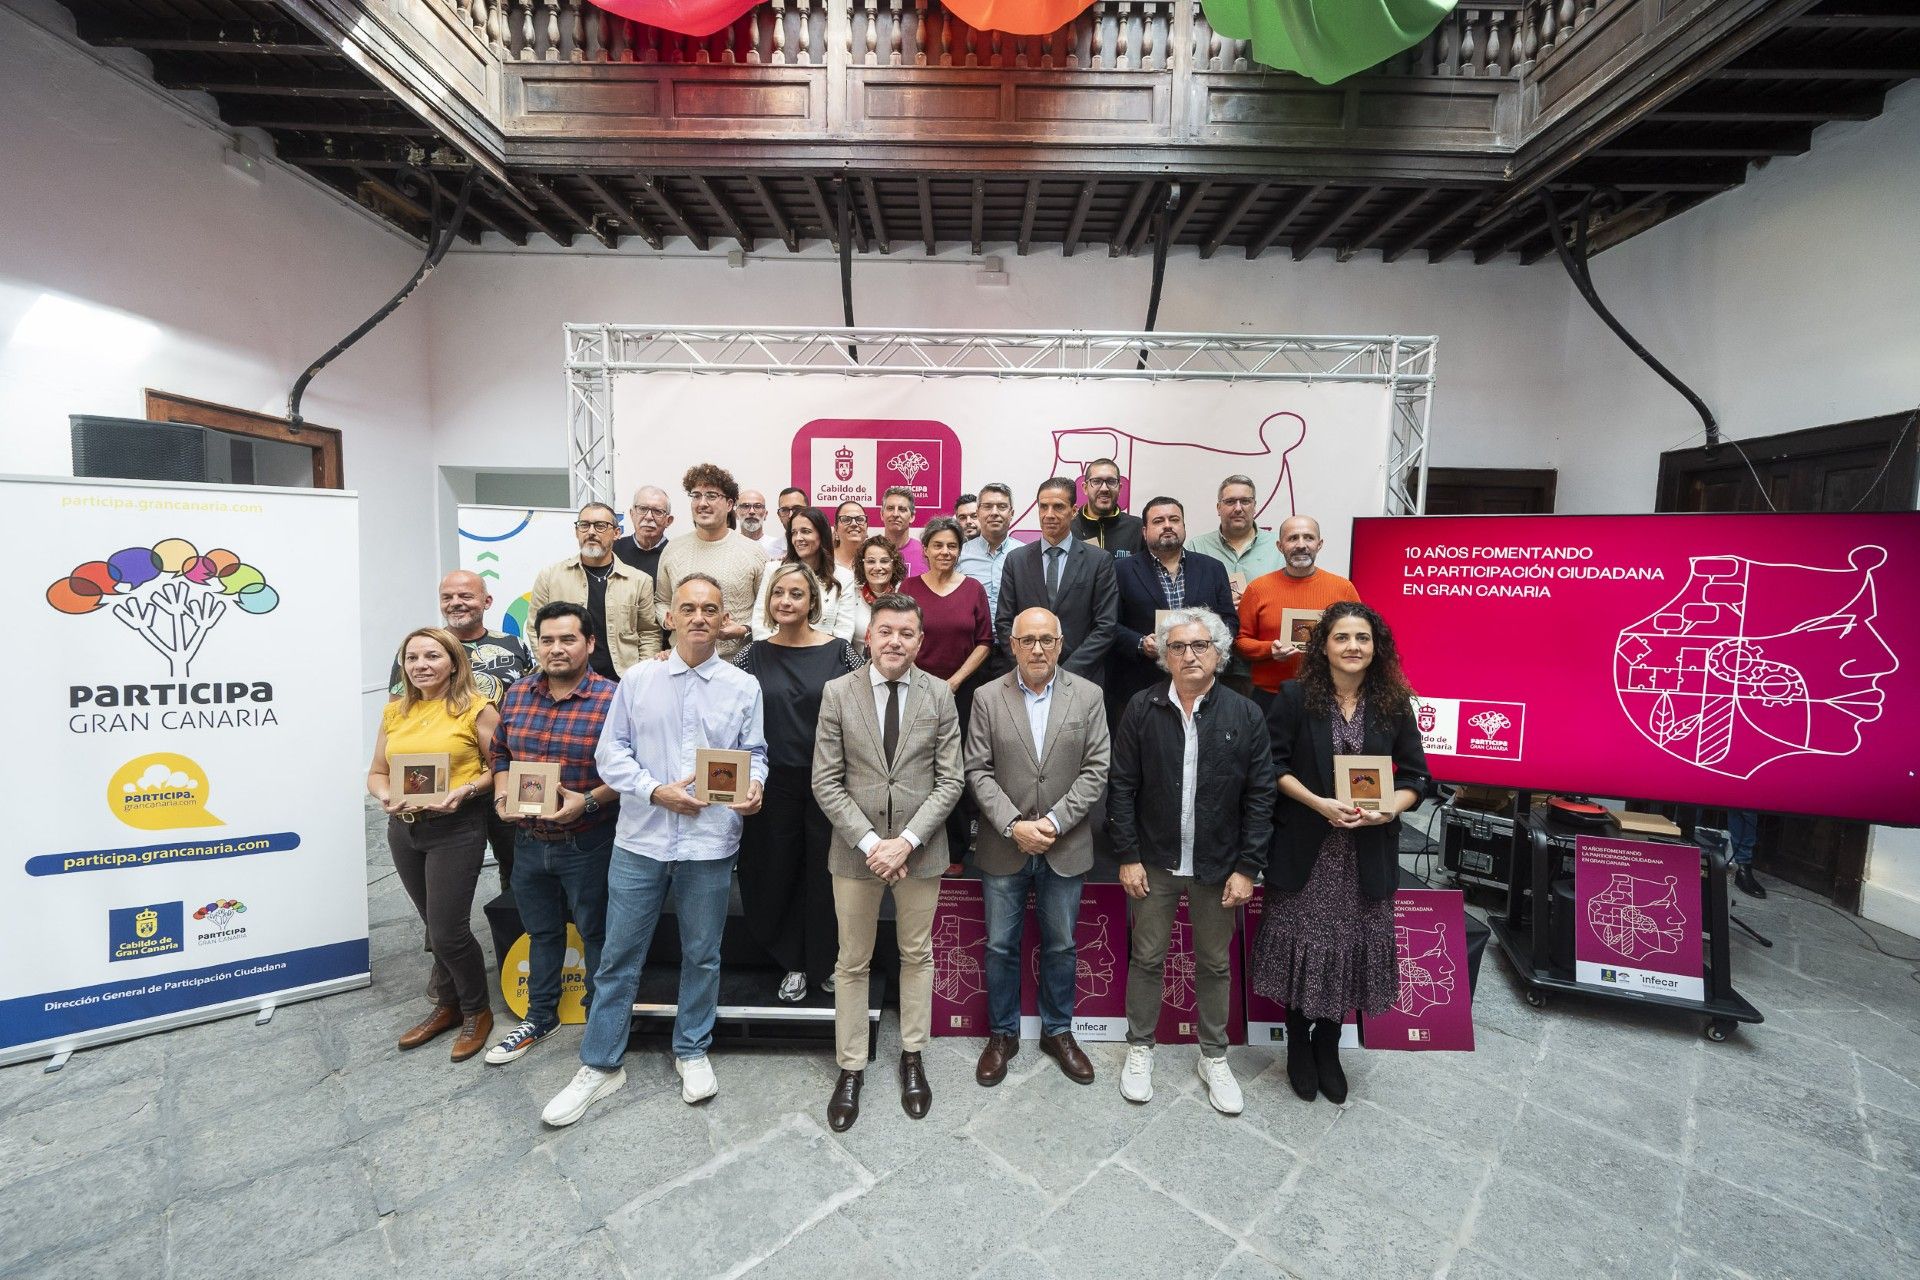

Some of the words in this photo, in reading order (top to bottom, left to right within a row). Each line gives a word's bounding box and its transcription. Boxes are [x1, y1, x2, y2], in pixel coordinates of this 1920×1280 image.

[820, 484, 854, 493] Cabildo
[855, 484, 867, 493] de
[61, 495, 264, 514] participa.grancanaria.com
[817, 493, 838, 501] Gran
[839, 493, 873, 501] Canaria
[1404, 547, 1421, 559] 10
[1424, 544, 1469, 559] AÑOS
[1471, 546, 1593, 560] FOMENTANDO
[1403, 565, 1425, 578] LA
[1427, 563, 1554, 579] PARTICIPACIÓN
[1557, 566, 1665, 580] CIUDADANA
[1403, 583, 1424, 595] EN
[1426, 584, 1473, 597] GRAN
[1475, 584, 1551, 598] CANARIA
[69, 712, 149, 734] GRAN
[161, 708, 279, 730] CANARIA
[124, 799, 197, 812] grancanaria.com
[63, 838, 270, 872] participa.grancanaria.com
[119, 939, 158, 950] Cabildo
[159, 936, 172, 944] de
[197, 938, 218, 947] GRAN
[219, 932, 247, 943] CANARIA
[115, 948, 139, 957] Gran
[140, 942, 179, 955] Canaria
[44, 994, 100, 1011] Dirección
[102, 986, 146, 1002] General
[147, 983, 162, 993] de
[164, 971, 232, 991] Participación
[234, 961, 287, 978] Ciudadana
[1640, 974, 1679, 988] infecar
[1075, 1021, 1107, 1031] infecar
